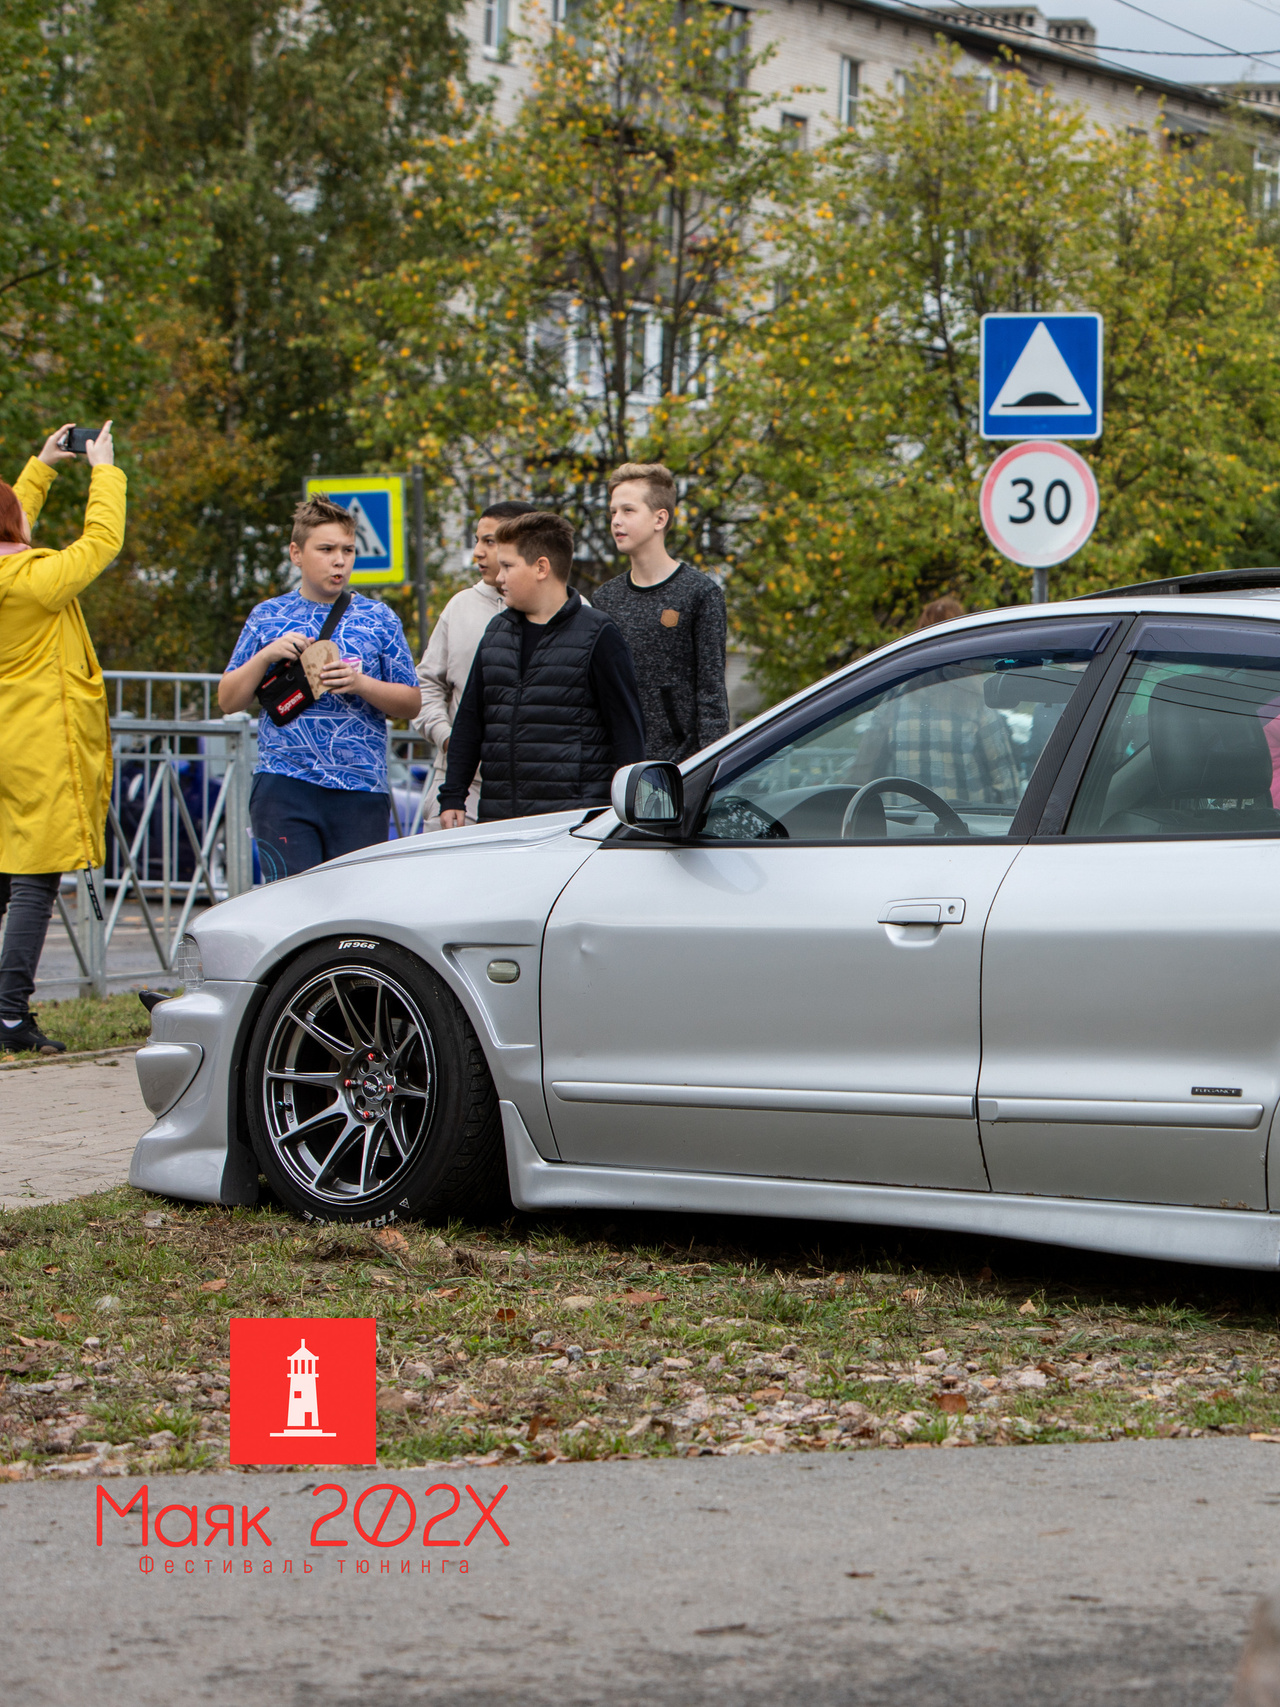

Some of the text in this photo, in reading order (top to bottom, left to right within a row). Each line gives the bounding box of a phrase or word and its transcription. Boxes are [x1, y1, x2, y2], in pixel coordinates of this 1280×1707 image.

[1008, 477, 1071, 525] 30
[278, 692, 304, 714] Supreme
[338, 939, 380, 950] TR968
[1194, 1087, 1238, 1095] ELEGANCE
